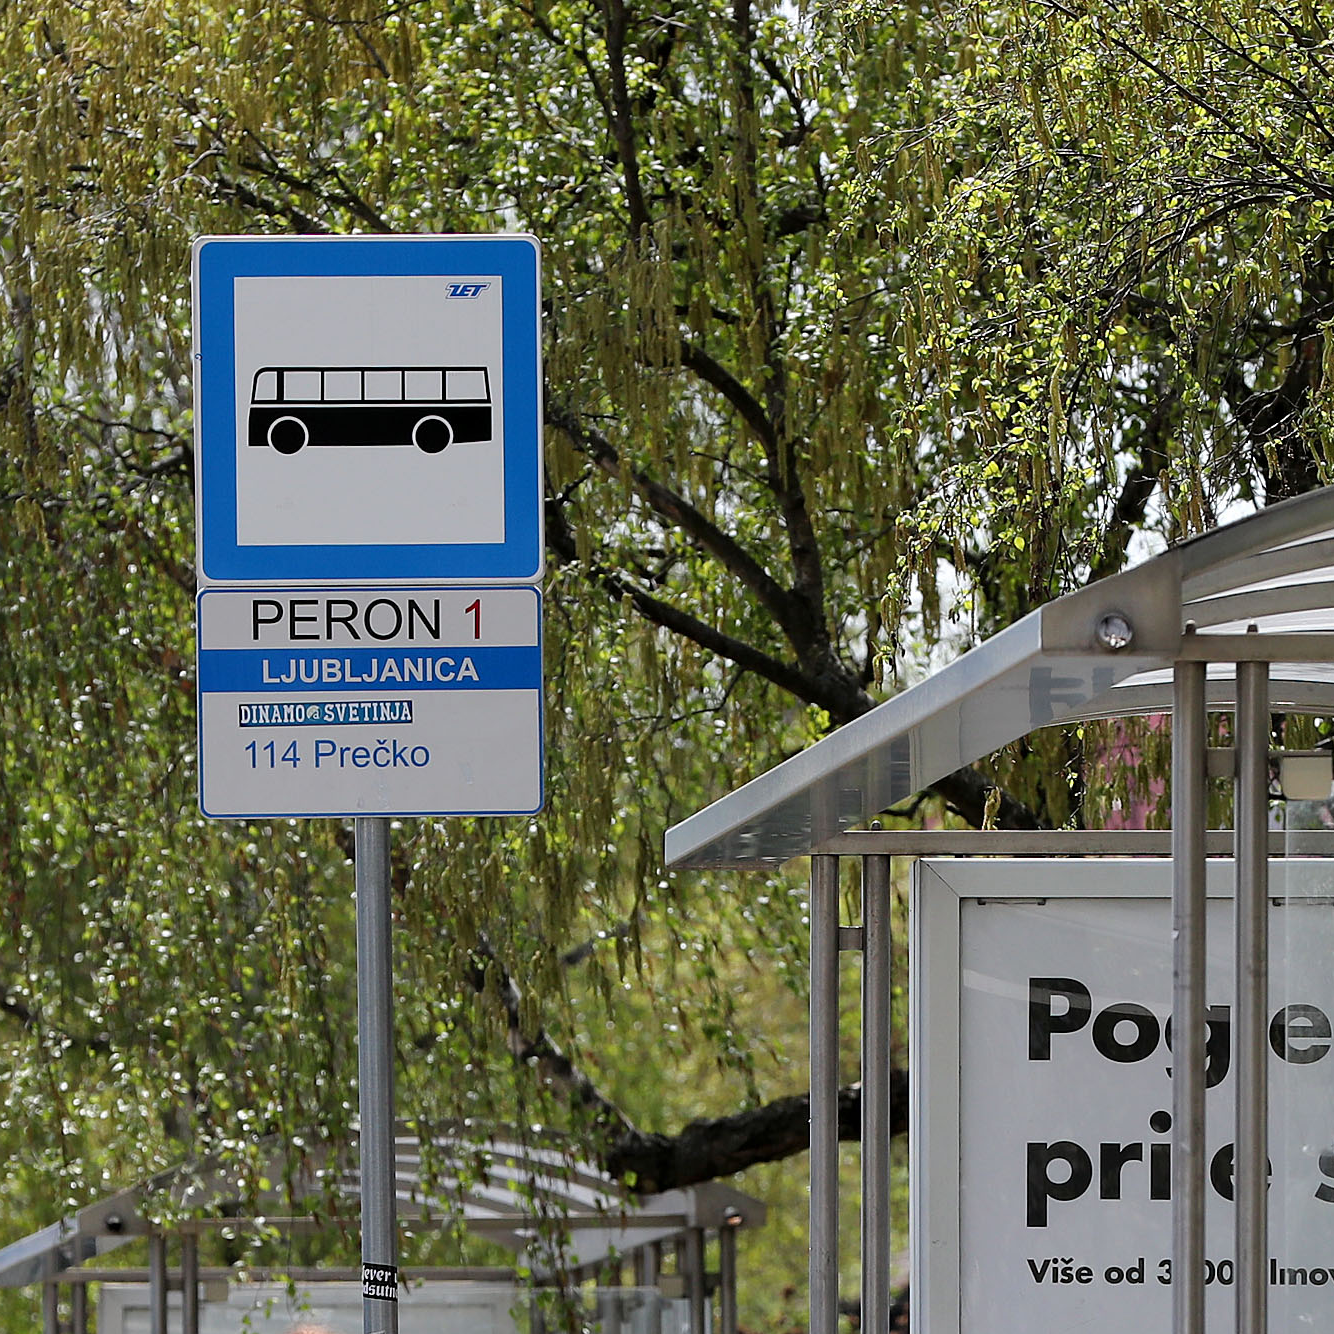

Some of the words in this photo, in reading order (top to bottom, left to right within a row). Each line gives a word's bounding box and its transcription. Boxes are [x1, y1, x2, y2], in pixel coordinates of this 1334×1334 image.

[446, 283, 491, 298] ZET
[251, 598, 441, 641] PERON
[464, 599, 482, 640] 1
[262, 657, 480, 684] LJUBLJANICA
[240, 704, 305, 724] DINAMO
[323, 702, 412, 722] SVETINJA
[244, 740, 301, 768] 114
[314, 738, 431, 769] Prečko
[1027, 1110, 1272, 1227] prie
[1027, 1257, 1093, 1284] Više
[1104, 1258, 1145, 1284] od
[1156, 1259, 1235, 1285] 300
